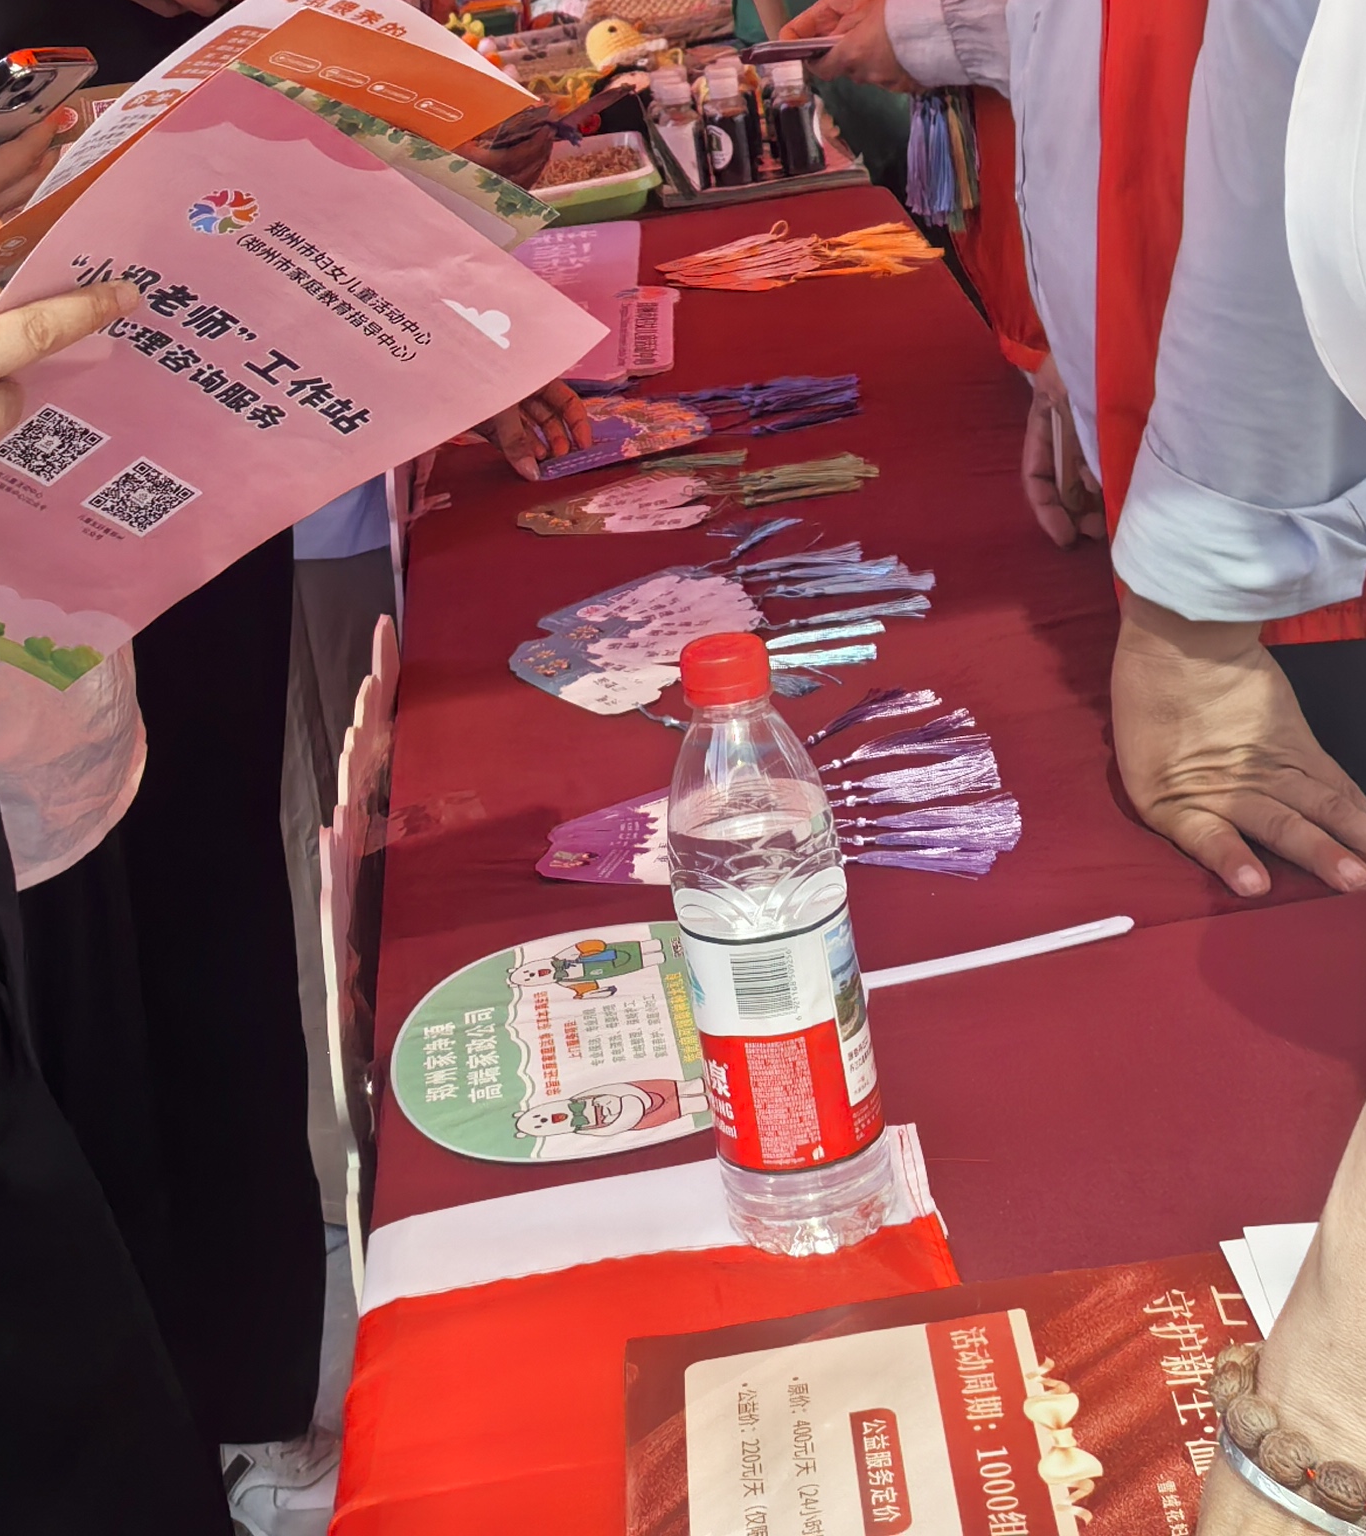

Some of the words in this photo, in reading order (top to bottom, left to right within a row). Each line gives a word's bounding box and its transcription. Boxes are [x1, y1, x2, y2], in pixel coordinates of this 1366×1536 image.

[264, 220, 432, 346] 郑州市妇女儿童活动中心
[423, 1021, 458, 1104] 郑州家净源
[464, 1006, 504, 1104] 高端家政公司
[861, 1418, 902, 1523] 公益服务定价
